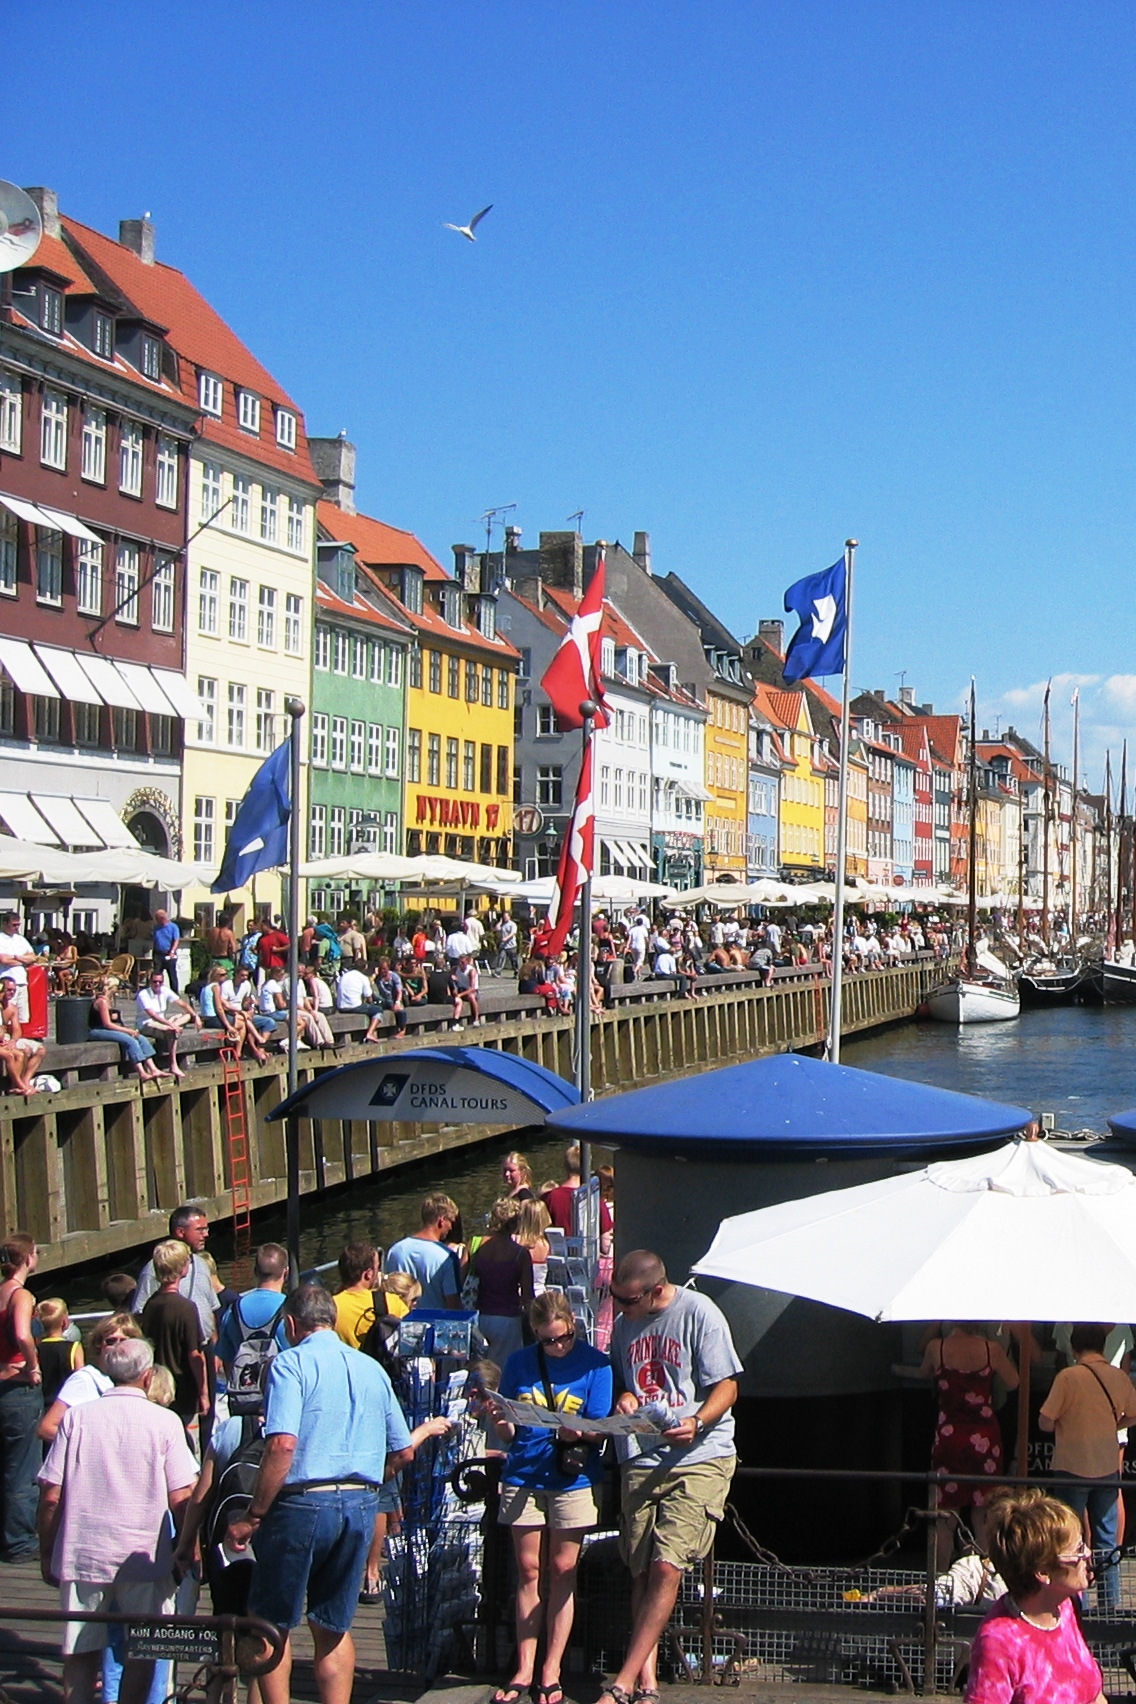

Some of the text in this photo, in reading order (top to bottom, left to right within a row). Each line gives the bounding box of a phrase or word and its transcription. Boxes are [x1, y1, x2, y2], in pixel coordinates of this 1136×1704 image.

[416, 795, 480, 830] NYHAVN
[515, 810, 536, 832] 17
[410, 1083, 446, 1095] DFDS
[411, 1097, 508, 1110] CANAL TOURS
[130, 1628, 218, 1641] KUN ADGANG FOR
